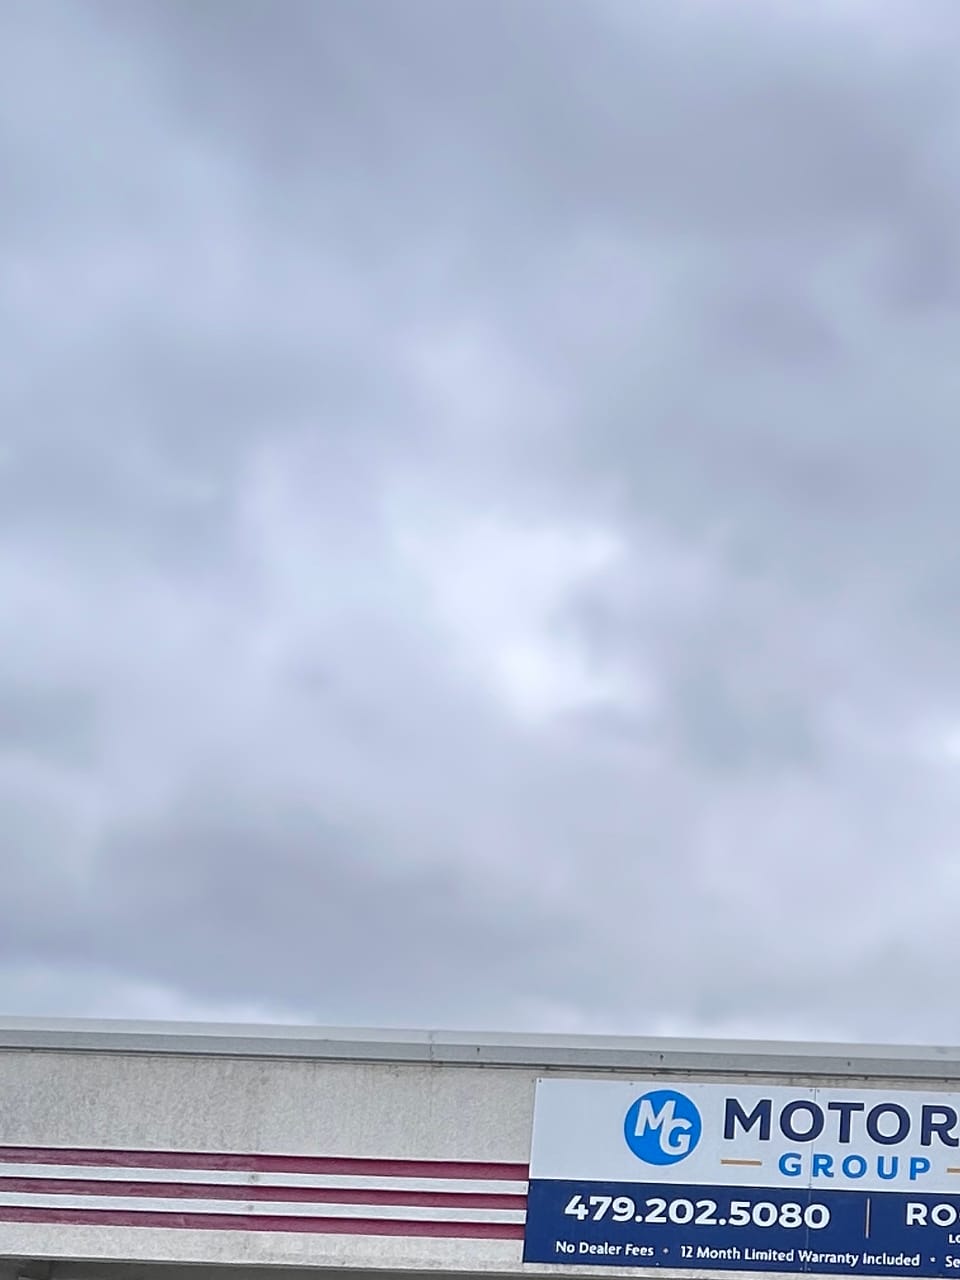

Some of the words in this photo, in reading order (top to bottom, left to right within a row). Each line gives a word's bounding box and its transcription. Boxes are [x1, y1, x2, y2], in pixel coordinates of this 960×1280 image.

[634, 1099, 692, 1156] MG
[778, 1152, 931, 1181] GROUP
[564, 1195, 831, 1230] 479.202.5080
[555, 1241, 576, 1254] No
[579, 1241, 622, 1256] Dealer
[625, 1243, 654, 1257] Fees
[680, 1245, 693, 1258] 12
[696, 1245, 740, 1260] Month
[744, 1248, 794, 1262] Limited
[798, 1249, 859, 1267] Warranty
[862, 1251, 921, 1267] Included
[945, 1255, 960, 1269] Se
